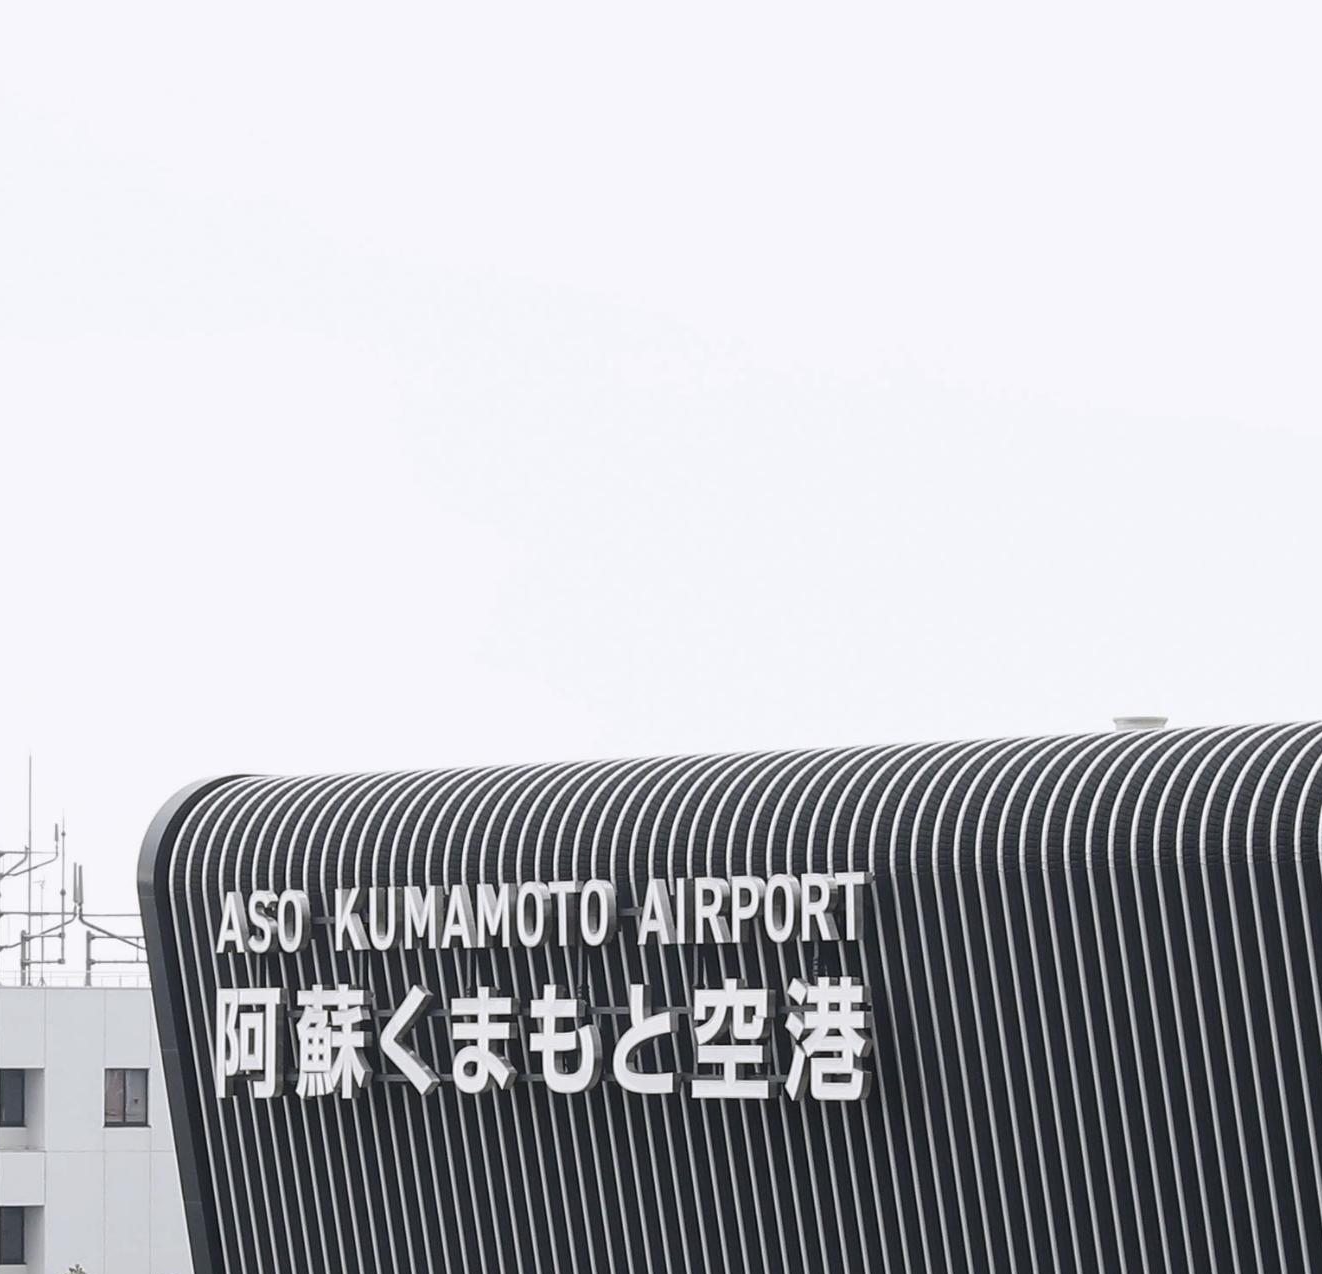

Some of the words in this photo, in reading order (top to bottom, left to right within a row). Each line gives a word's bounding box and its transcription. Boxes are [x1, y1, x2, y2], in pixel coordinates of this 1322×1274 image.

[216, 889, 312, 954] ASO
[334, 878, 619, 952] KUMAMOTO
[638, 871, 873, 947] AIRPORT
[216, 976, 870, 1101] 阿蘇くまもと空港
